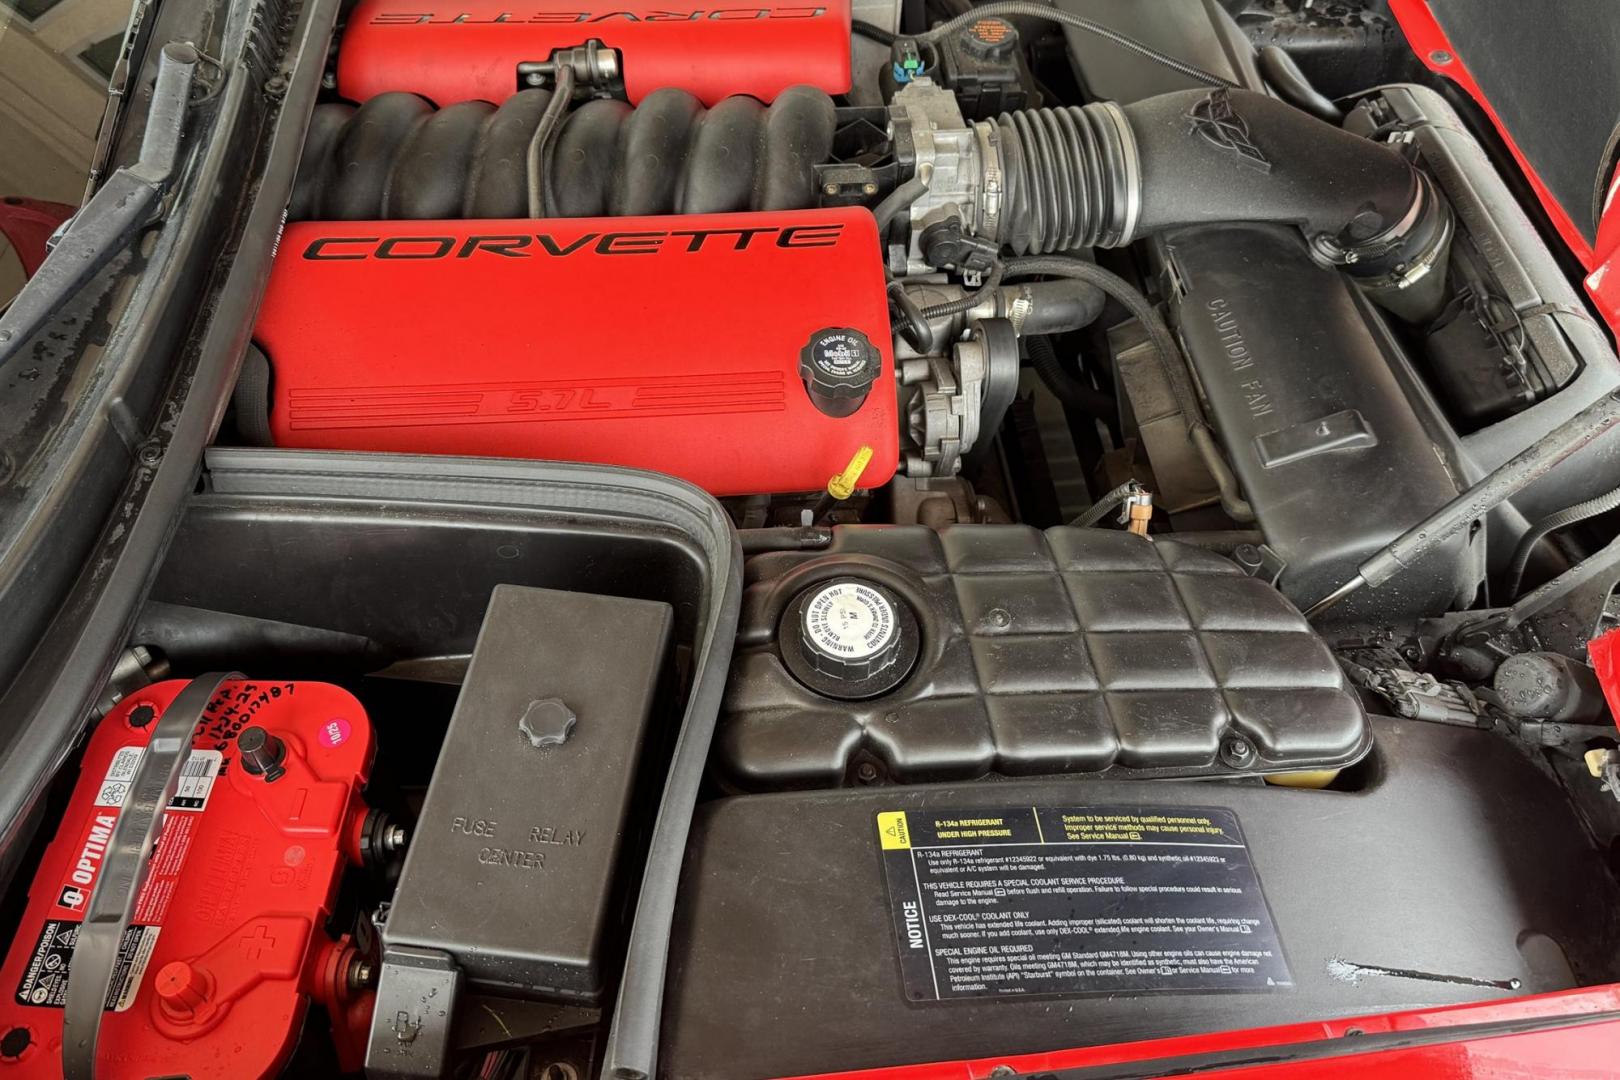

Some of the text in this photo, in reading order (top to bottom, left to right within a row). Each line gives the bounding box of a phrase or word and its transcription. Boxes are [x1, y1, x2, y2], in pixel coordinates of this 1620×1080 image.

[301, 224, 845, 260] CORVETTE
[820, 335, 846, 346] ENGINE
[848, 336, 858, 346] OIL
[1207, 298, 1272, 417] CAUTION FAN
[507, 388, 613, 412] 5.7L
[814, 594, 830, 610] OPEN
[829, 588, 843, 598] HOT
[856, 586, 882, 606] PRESSURE
[812, 624, 822, 634] DO
[867, 624, 890, 649] CONTENTS
[822, 636, 854, 652] WARNING
[451, 817, 498, 838] FUSE
[935, 820, 958, 828] R-134a
[1062, 815, 1086, 824] System
[1140, 817, 1166, 825] qualified
[1167, 818, 1196, 826] personnel
[1064, 824, 1092, 832] Improper
[528, 826, 586, 846] RELAY
[72, 816, 117, 884] OPTIMA
[478, 848, 546, 869] CENTER
[904, 902, 924, 948] NOTICE
[23, 922, 57, 989] DANGER/POISON
[936, 948, 962, 956] SPECIAL
[1000, 945, 1033, 953] REQUIRED
[961, 957, 980, 965] engine
[982, 956, 1006, 964] requires
[1007, 955, 1027, 963] special
[1037, 954, 1060, 962] meeting
[982, 964, 1008, 973] warranty.
[1022, 963, 1046, 971] meeting
